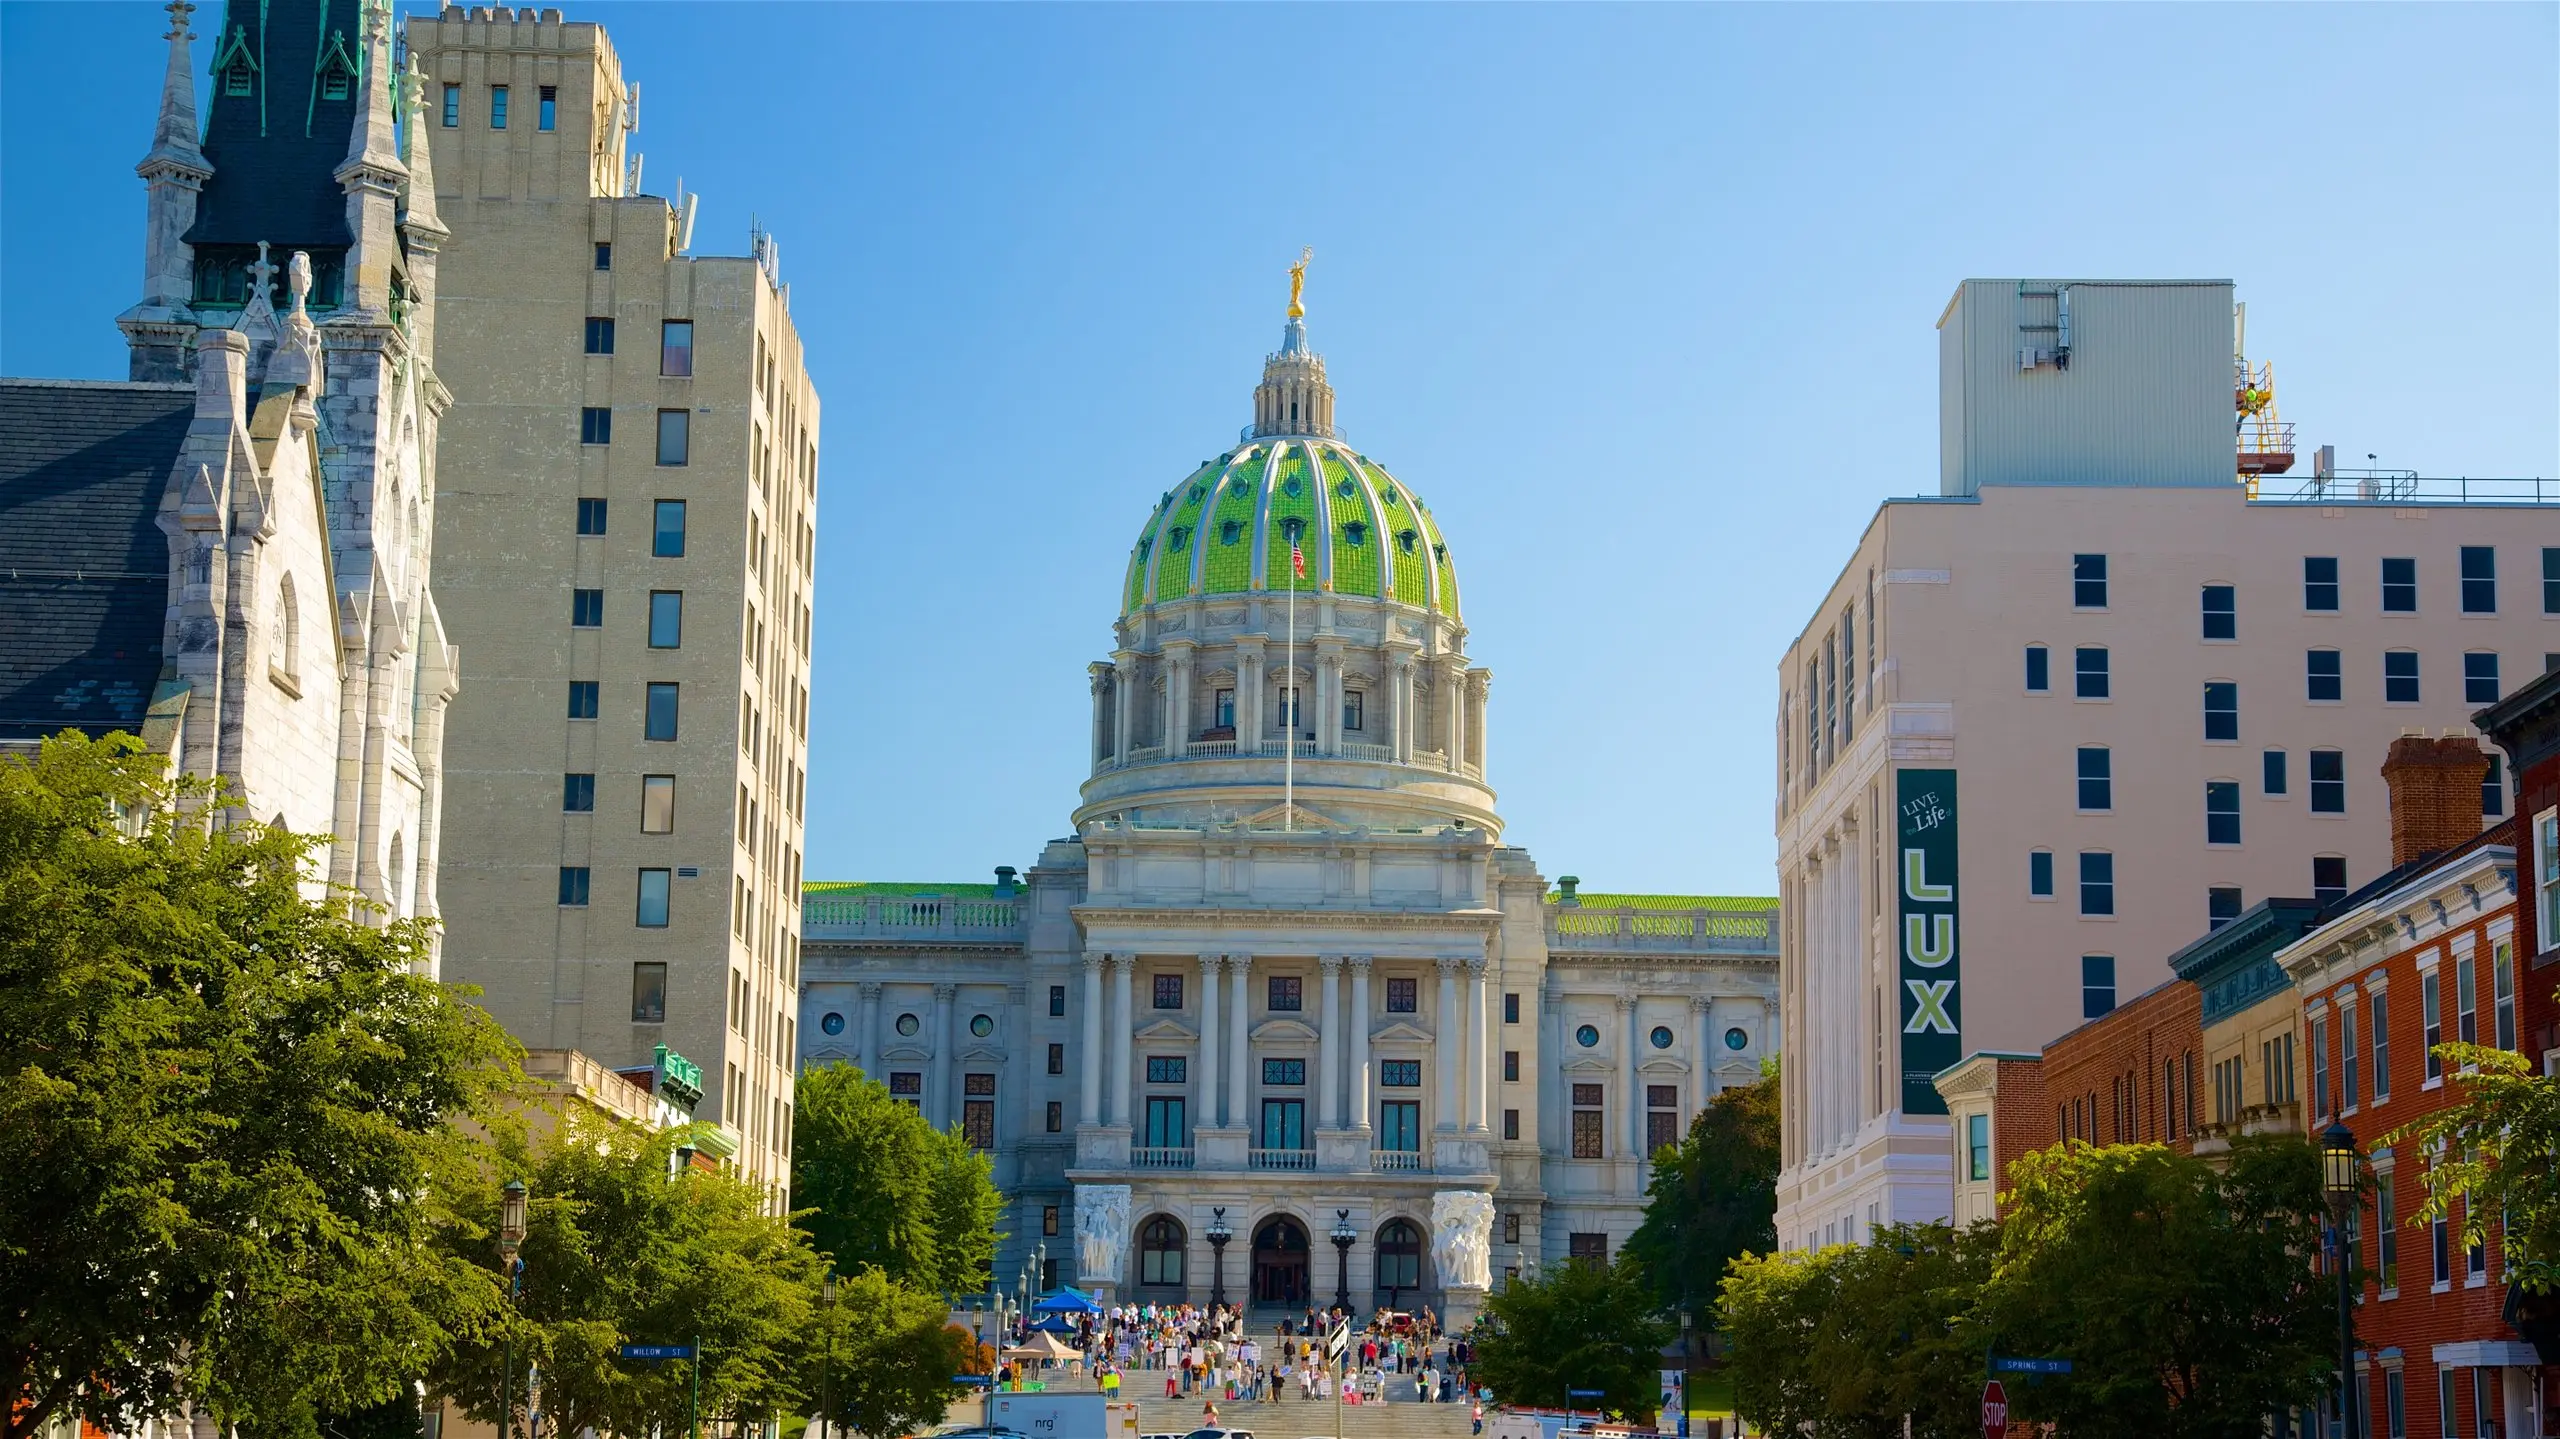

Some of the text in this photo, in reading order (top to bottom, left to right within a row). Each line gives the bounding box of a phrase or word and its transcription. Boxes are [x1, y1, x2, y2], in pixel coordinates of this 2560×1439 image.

[1902, 792, 1939, 816] LIVE
[1914, 805, 1946, 832] Life
[1903, 848, 1959, 1034] LUX
[633, 1348, 681, 1356] WILLOW ST
[2007, 1360, 2058, 1371] SPRING ST
[1035, 1419, 1054, 1431] nrg
[1984, 1401, 2006, 1427] STOP
